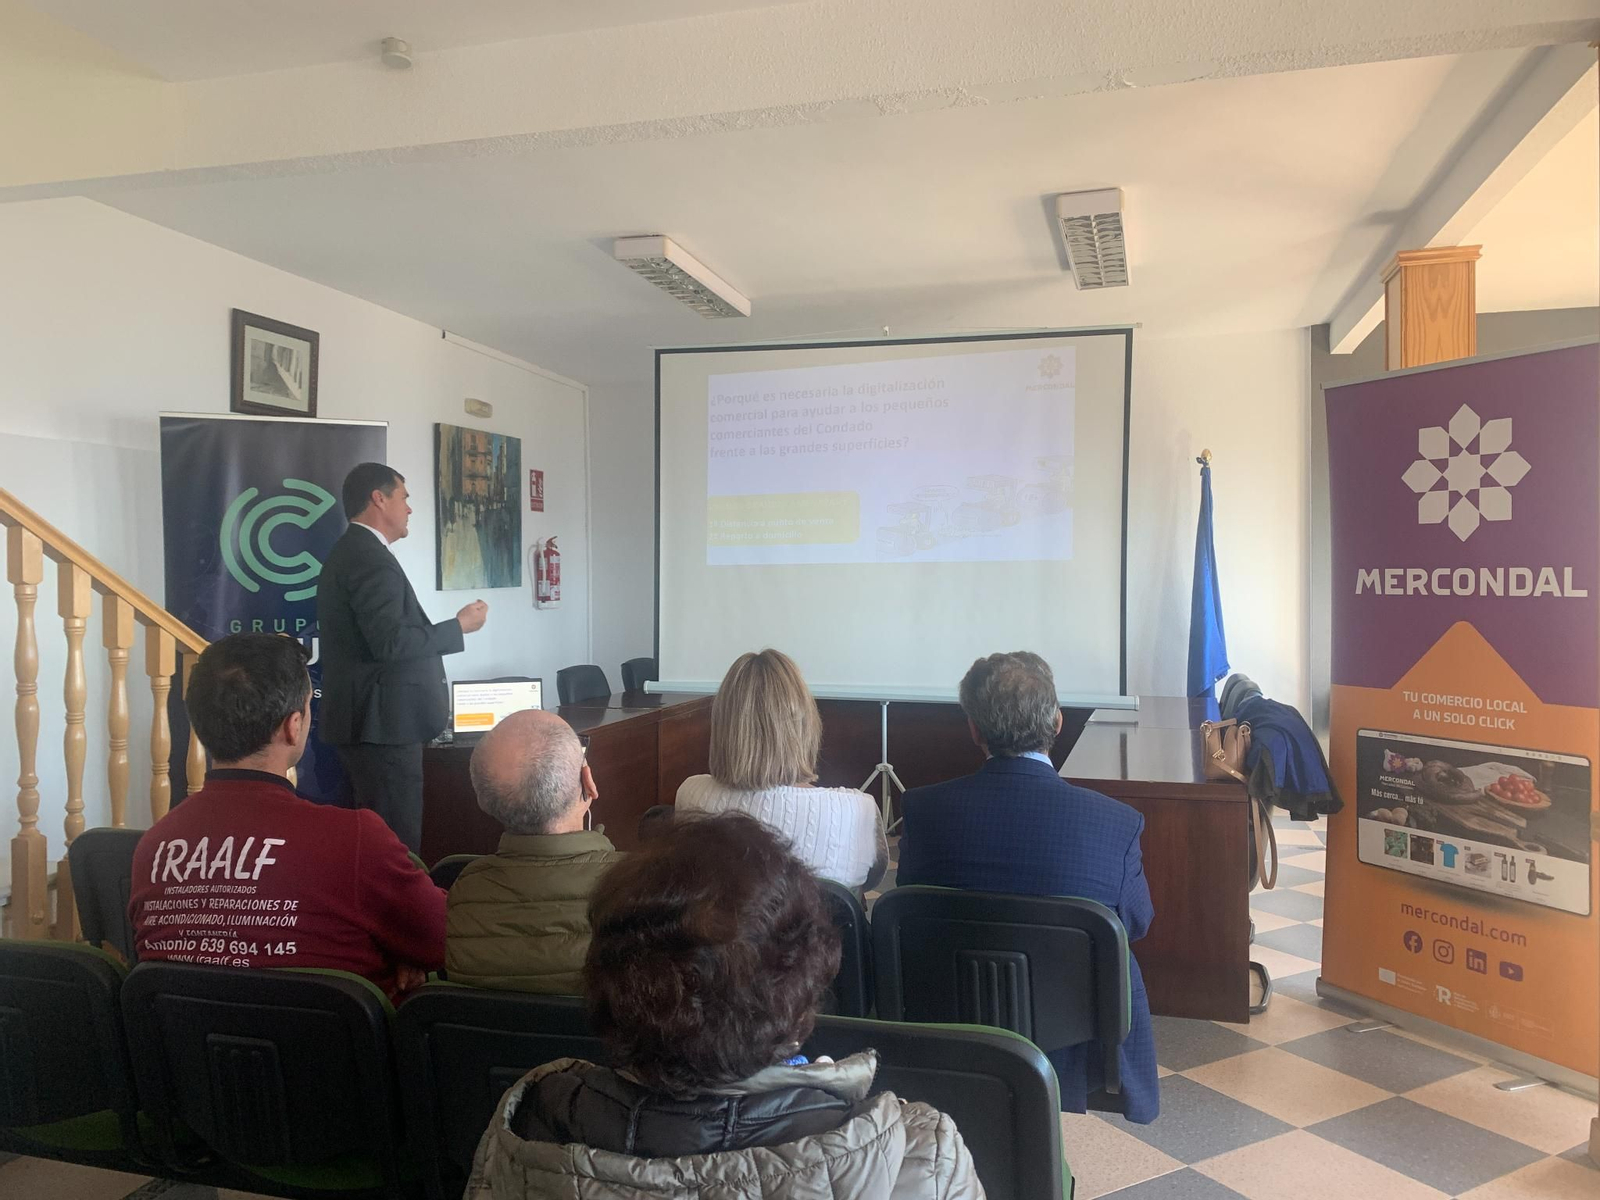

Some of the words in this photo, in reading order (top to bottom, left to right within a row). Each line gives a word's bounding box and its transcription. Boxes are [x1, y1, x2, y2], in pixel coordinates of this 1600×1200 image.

[711, 391, 760, 407] ¿Porqué
[763, 392, 776, 402] es
[780, 386, 838, 401] necesaria
[843, 384, 854, 396] la
[858, 376, 945, 396] digitalización
[710, 408, 768, 423] comercial
[771, 408, 799, 422] para
[802, 403, 846, 418] ayudar
[849, 404, 857, 414] a
[861, 400, 879, 413] los
[883, 396, 949, 414] pequeños
[710, 426, 790, 441] comerciantes
[793, 424, 812, 436] del
[816, 421, 873, 435] Condado
[710, 446, 746, 459] frente
[749, 447, 756, 456] a
[760, 444, 776, 456] las
[780, 441, 828, 457] grandes
[832, 437, 910, 454] superficies?
[1355, 566, 1589, 597] MERCONDAL
[1403, 690, 1419, 703] TU
[1421, 693, 1483, 709] COMERCIO
[1486, 699, 1528, 714] LOCAL
[1413, 708, 1421, 720] A
[1424, 710, 1440, 722] UN
[1443, 712, 1476, 726] SOLO
[1479, 716, 1516, 730] CLICK
[1379, 775, 1416, 786] MERCONDAL
[151, 836, 286, 883] IRAALF
[164, 885, 209, 895] INSTALADORES
[210, 884, 257, 895] AUTORIZADOS
[143, 898, 199, 911] INSTALACIONES
[201, 898, 207, 908] Y
[208, 898, 281, 911] REPARACIONES
[283, 899, 299, 911] DE
[158, 913, 226, 927] ACONDICIONADO,
[226, 913, 298, 927] ILUMINACIÓN
[1401, 902, 1527, 947] mercondal.com
[144, 938, 197, 951] Antonio
[200, 937, 226, 953] 639
[229, 940, 258, 956] 694
[264, 941, 297, 956] 145
[167, 953, 250, 968] wwwiraalf.es
